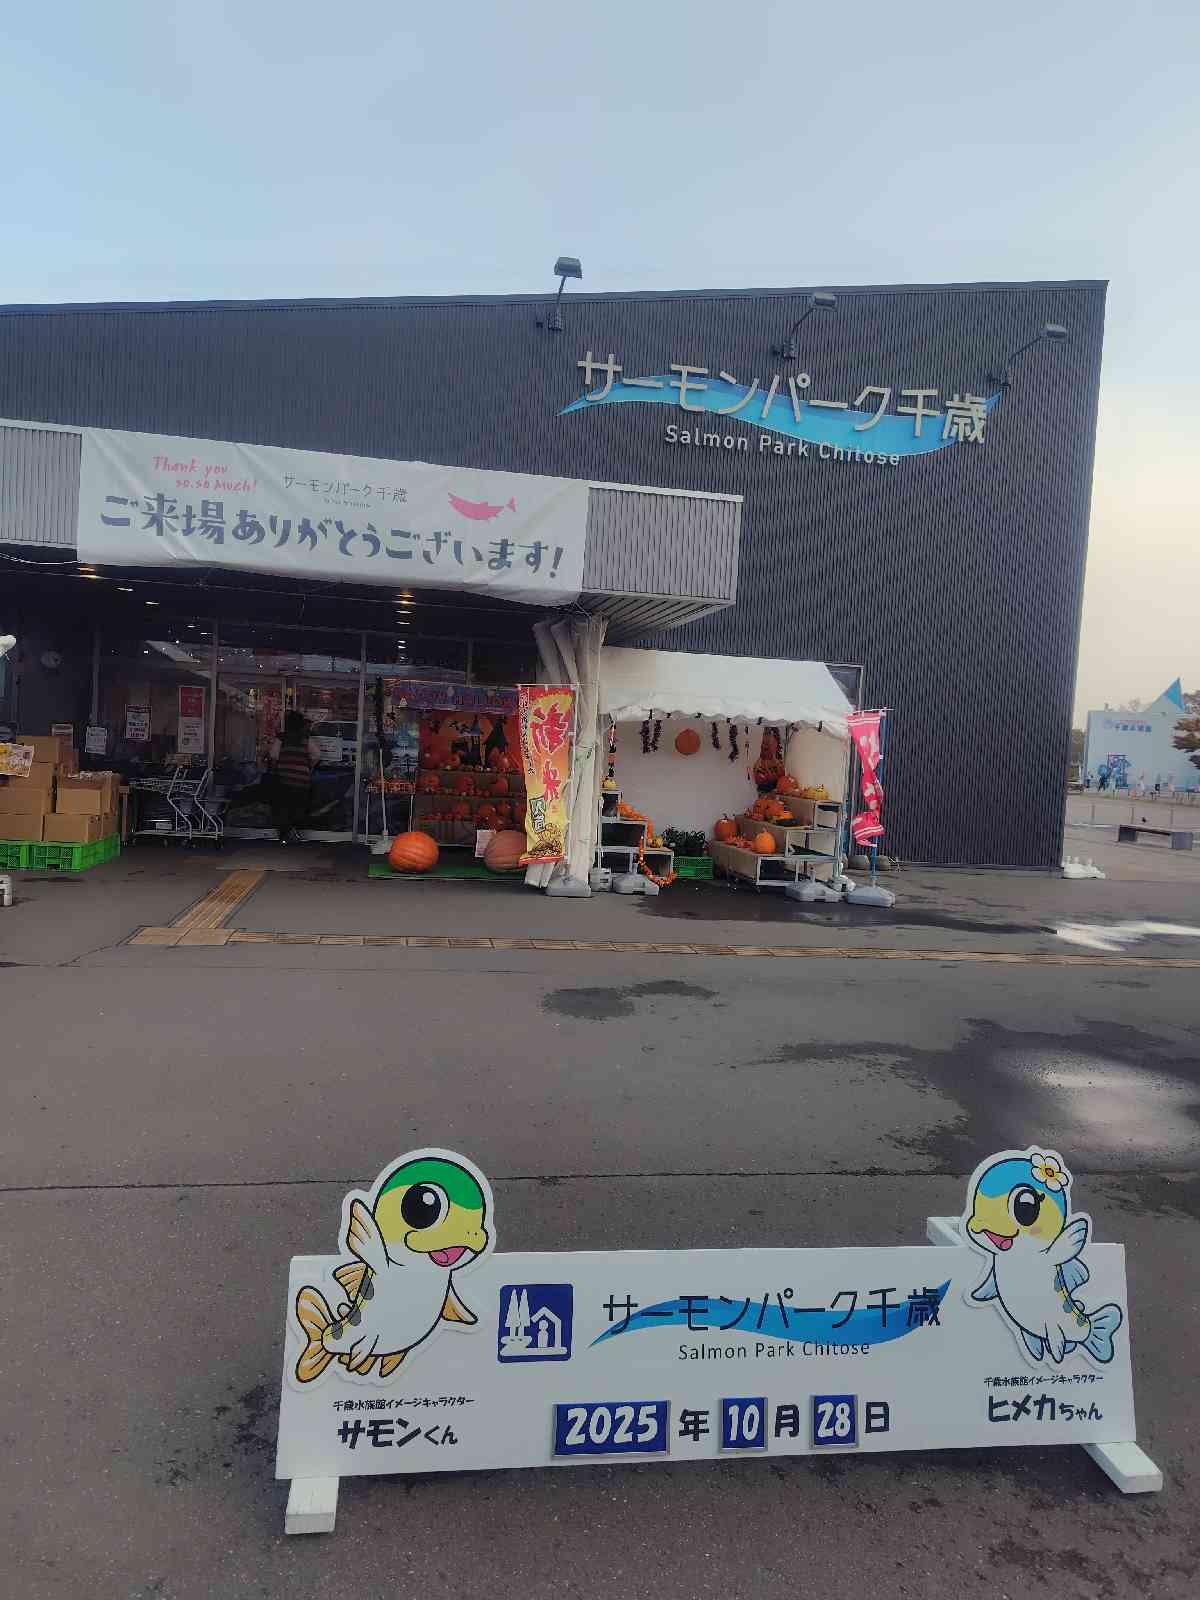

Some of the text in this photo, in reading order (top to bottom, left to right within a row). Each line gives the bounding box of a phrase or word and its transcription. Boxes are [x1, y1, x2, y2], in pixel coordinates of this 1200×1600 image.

[577, 351, 988, 444] サーモンパーク千歳
[665, 424, 900, 466] Salmon Park Chitose
[152, 456, 228, 479] Thank you
[602, 1287, 942, 1333] サーモンパーク千歳
[678, 1341, 871, 1361] Salmon Park Chitose
[988, 1393, 1103, 1422] ヒメカちゃん
[337, 1418, 458, 1449] サモンくん
